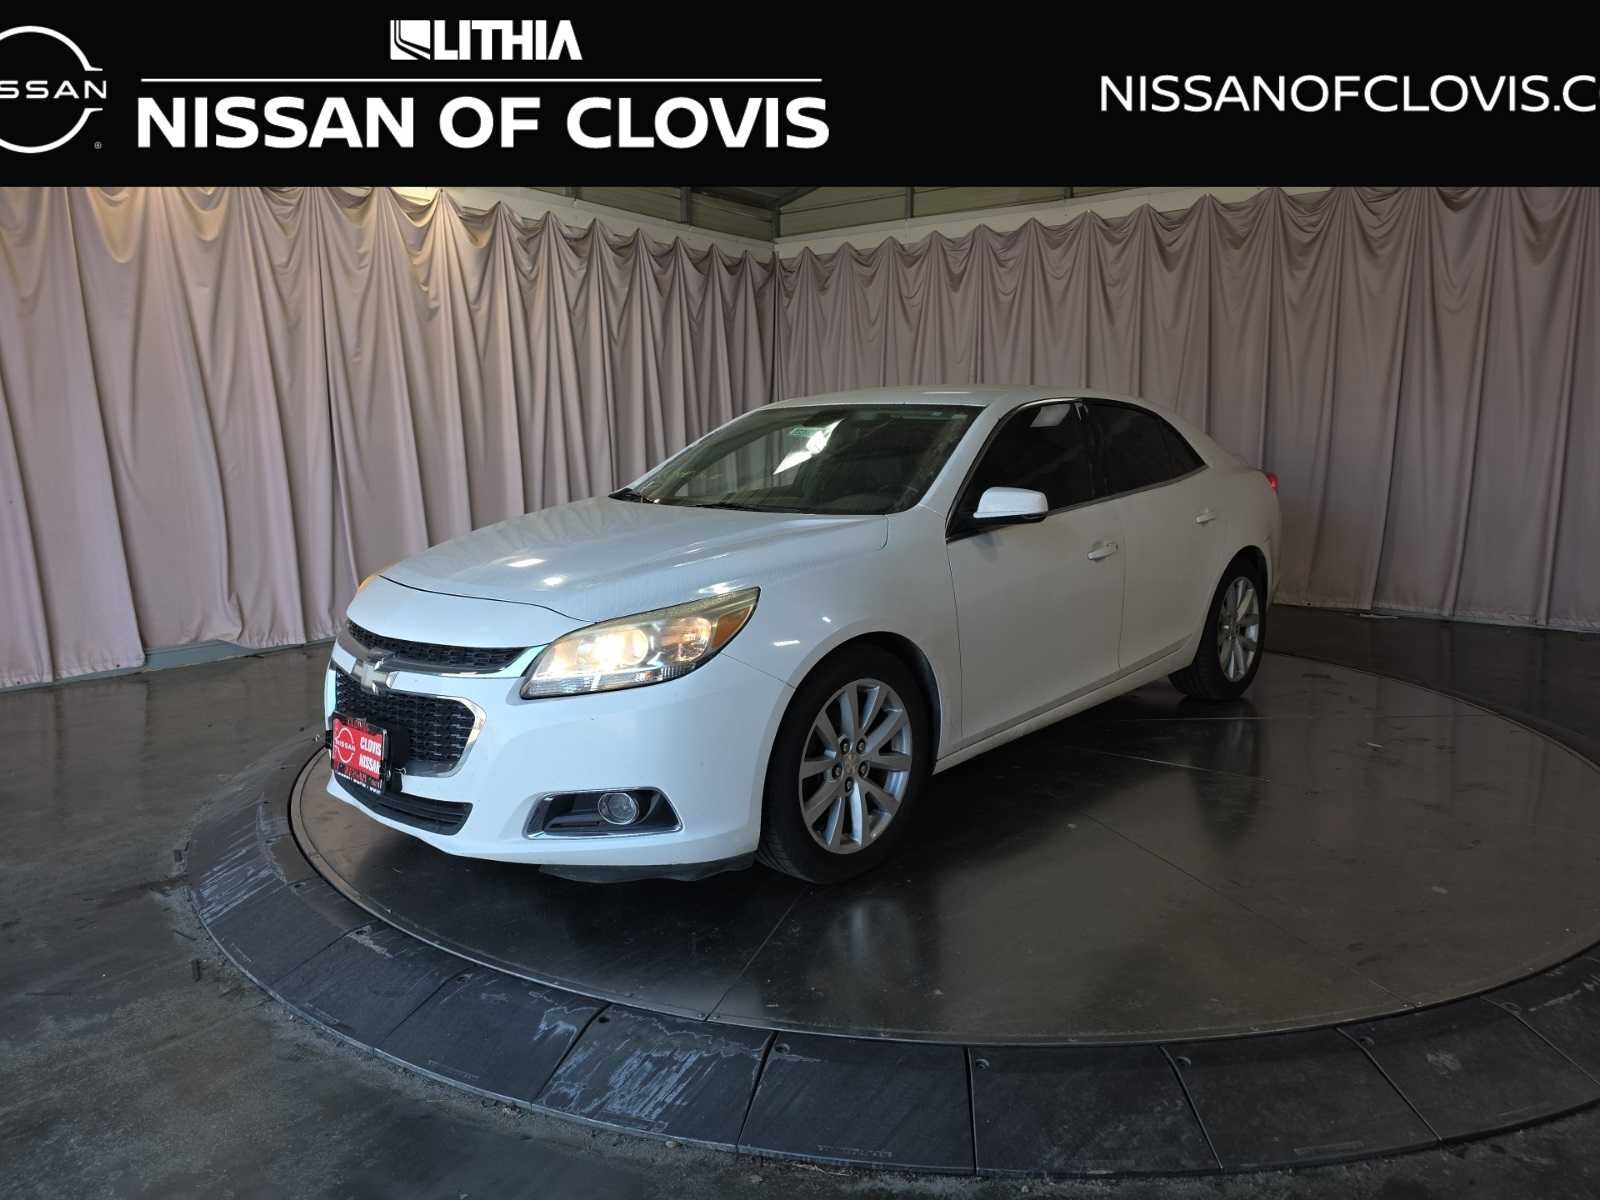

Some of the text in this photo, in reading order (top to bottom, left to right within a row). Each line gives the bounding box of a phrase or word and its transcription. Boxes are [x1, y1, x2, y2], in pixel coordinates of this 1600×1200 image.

[334, 740, 356, 752] NISSAN
[360, 736, 382, 756] CLOVIS
[359, 753, 381, 774] NISSAN
